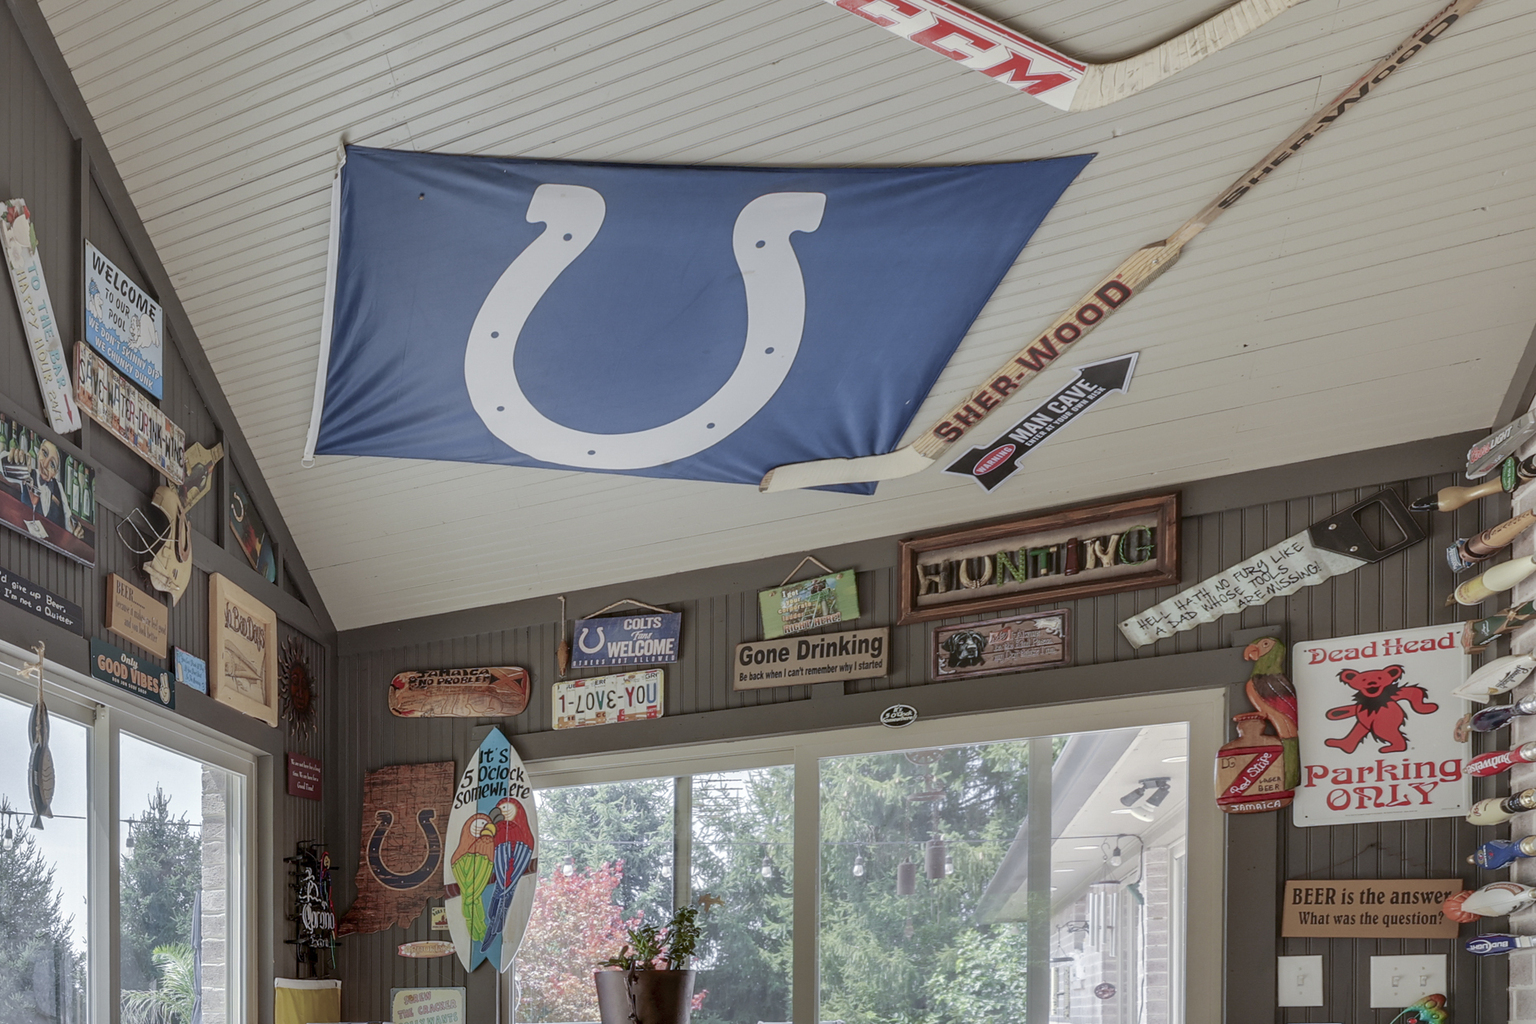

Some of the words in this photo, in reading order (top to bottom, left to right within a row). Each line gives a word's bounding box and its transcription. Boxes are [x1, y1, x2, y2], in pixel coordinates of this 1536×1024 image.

[92, 251, 157, 322] WELCOME
[105, 288, 114, 303] TO
[115, 298, 131, 320] OUR
[16, 270, 39, 330] HAPPY
[34, 338, 53, 385] HOUR
[27, 261, 41, 291] TO
[37, 299, 55, 342] THE
[50, 349, 66, 390] BAR
[108, 308, 127, 333] POOL
[88, 314, 100, 332] WE
[100, 326, 121, 350] DON'T
[121, 343, 147, 369] SKINNY
[147, 362, 161, 381] DIP
[95, 335, 106, 351] WE
[107, 344, 134, 375] CHUNKY
[134, 367, 154, 391] DUNK
[931, 277, 1133, 444] SHER-WOOD
[1007, 411, 1054, 445] MAN
[1047, 378, 1098, 415] CAVE
[1024, 430, 1048, 447] ENTER
[1053, 411, 1074, 427] YOUR
[1073, 398, 1090, 413] OWN
[1089, 386, 1107, 401] RISK
[1490, 426, 1513, 448] LIGHT
[975, 445, 1013, 474] WARNING
[916, 523, 1156, 597] HUNTING
[11, 581, 27, 594] give
[1137, 611, 1171, 630] HELL
[1174, 587, 1211, 611] HATH
[1214, 578, 1230, 592] NO
[1233, 559, 1270, 582] FURY
[1269, 541, 1305, 565] LIKE
[1155, 626, 1167, 637] A
[1167, 610, 1198, 629] DAD
[1200, 585, 1246, 612] WHOSE
[1247, 564, 1290, 589] TOOLS
[1237, 591, 1267, 609] ARE
[1265, 560, 1324, 595] MISSING!
[4, 587, 17, 601] I'm
[44, 606, 73, 626] Quitter
[624, 617, 662, 630] COLTS
[631, 631, 653, 641] Fans
[120, 653, 139, 669] Only
[607, 638, 675, 658] WELCOME
[634, 655, 675, 664] ALLOWED
[739, 645, 790, 667] Gone
[797, 634, 883, 661] Drinking
[1308, 641, 1378, 665] Dead
[1381, 631, 1456, 657] Head
[97, 654, 128, 681] GOOD
[130, 667, 160, 694] VIBES
[739, 672, 748, 682] Be
[749, 670, 764, 681] back
[765, 669, 783, 679] when
[787, 667, 804, 677] can't
[805, 664, 838, 676] remember
[839, 661, 853, 674] why
[858, 659, 883, 670] started
[479, 748, 509, 764] It's
[460, 768, 475, 788] 5
[478, 765, 525, 783] O'clock
[1229, 776, 1252, 793] Red
[1246, 752, 1272, 778] Stripe
[1258, 784, 1280, 792] BEER
[1304, 757, 1463, 789] Parking
[1230, 800, 1282, 812] JAMAICA
[1326, 781, 1440, 811] ONLY
[1292, 887, 1336, 905] BEER
[1341, 888, 1355, 904] is
[1359, 888, 1386, 905] the
[1389, 889, 1452, 905] answer
[1298, 910, 1331, 926] What
[1333, 912, 1357, 926] was
[1359, 911, 1379, 926] the
[1382, 911, 1445, 928] question?
[397, 1007, 414, 1020] THE
[417, 999, 457, 1016] CRACKER
